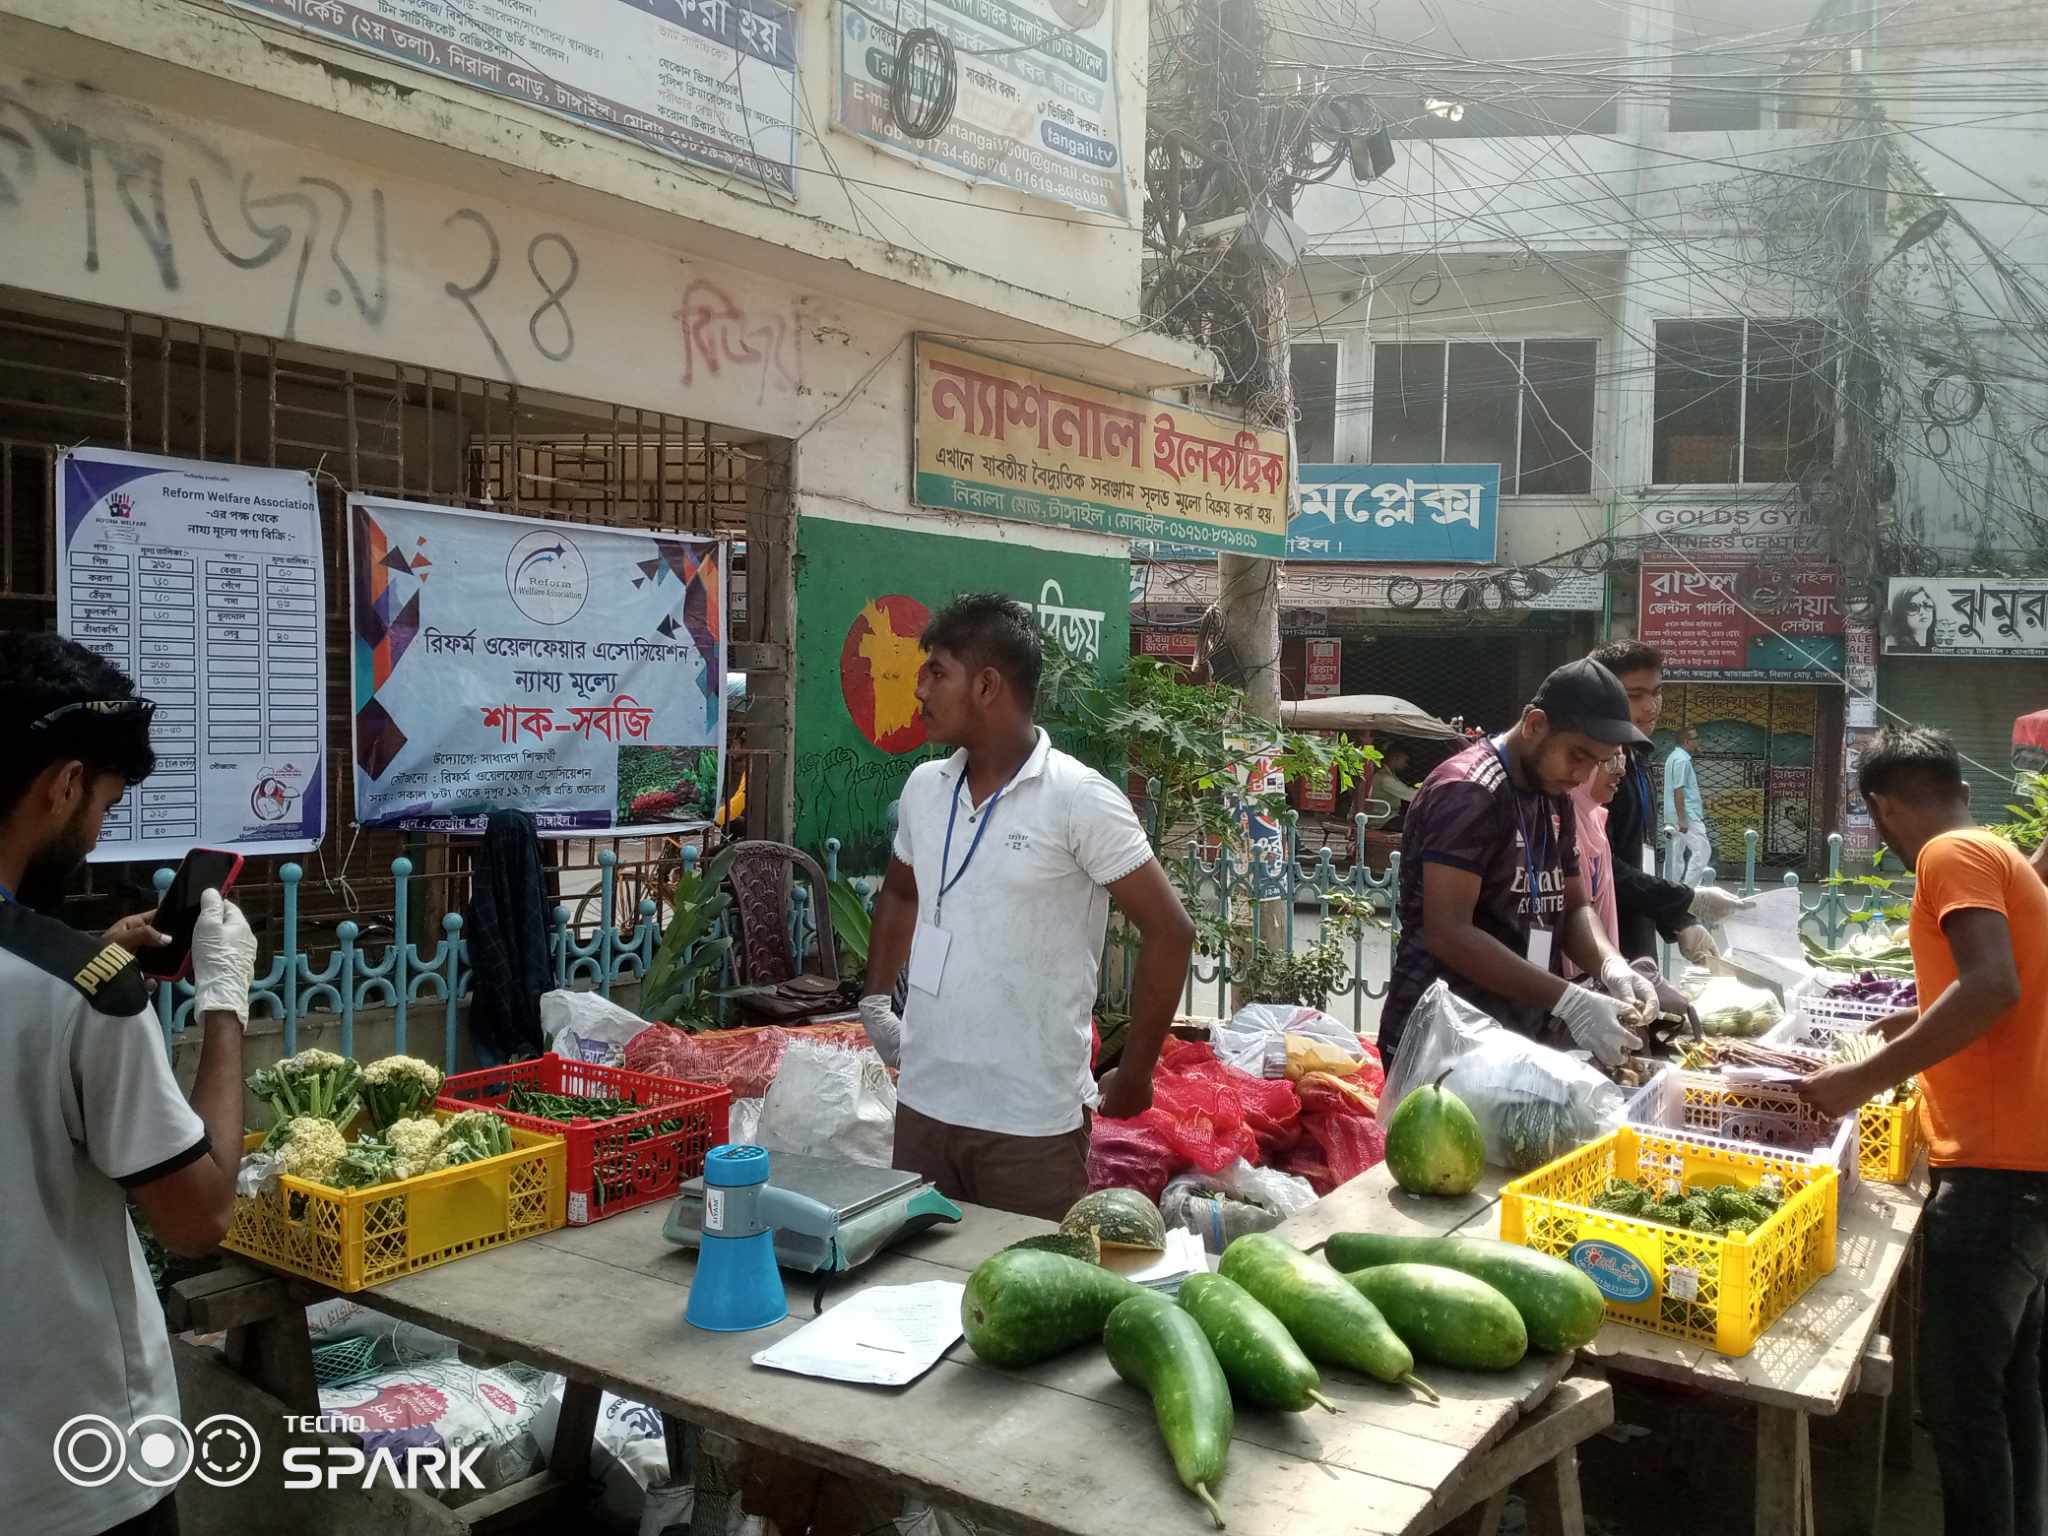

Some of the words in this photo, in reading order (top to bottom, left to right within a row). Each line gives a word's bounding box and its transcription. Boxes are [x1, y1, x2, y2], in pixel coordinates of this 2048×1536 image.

[1046, 127, 1114, 162] tangail.tv
[443, 207, 581, 388] ২৪
[929, 359, 1148, 469] ন্যাশনাল
[161, 486, 206, 502] Reform
[207, 489, 251, 506] Welfare
[253, 495, 316, 513] Association
[936, 447, 974, 473] এখানে
[981, 453, 1028, 483] যাবতীয়
[1032, 459, 1086, 493] বৈদ্যুতিক
[1090, 476, 1136, 502] সরঞ্জাম
[1205, 491, 1231, 519] বিক্রয়
[1233, 502, 1254, 522] করা
[952, 480, 1005, 512] নিরালা
[252, 511, 280, 524] থেকে
[1298, 477, 1487, 531] মপ্লেক্স
[1655, 508, 1750, 526] GOLDS
[1648, 568, 1739, 598] রাহুল
[1648, 599, 1691, 617] জেন্টস
[1696, 600, 1738, 618] পার্লার
[1780, 617, 1826, 634] সেন্টার
[424, 626, 478, 656] রিফর্ম
[482, 637, 588, 661] ওয়েলফেয়ার
[592, 636, 690, 665] এসোসিয়েশন
[513, 669, 564, 694] ন্যায্য
[568, 671, 619, 700] মূল্যে
[479, 693, 657, 745] শাক-সবজি
[480, 751, 519, 766] সাধারণ
[439, 768, 472, 785] রিফর্ম
[475, 768, 534, 783] ওয়েলফেয়ার
